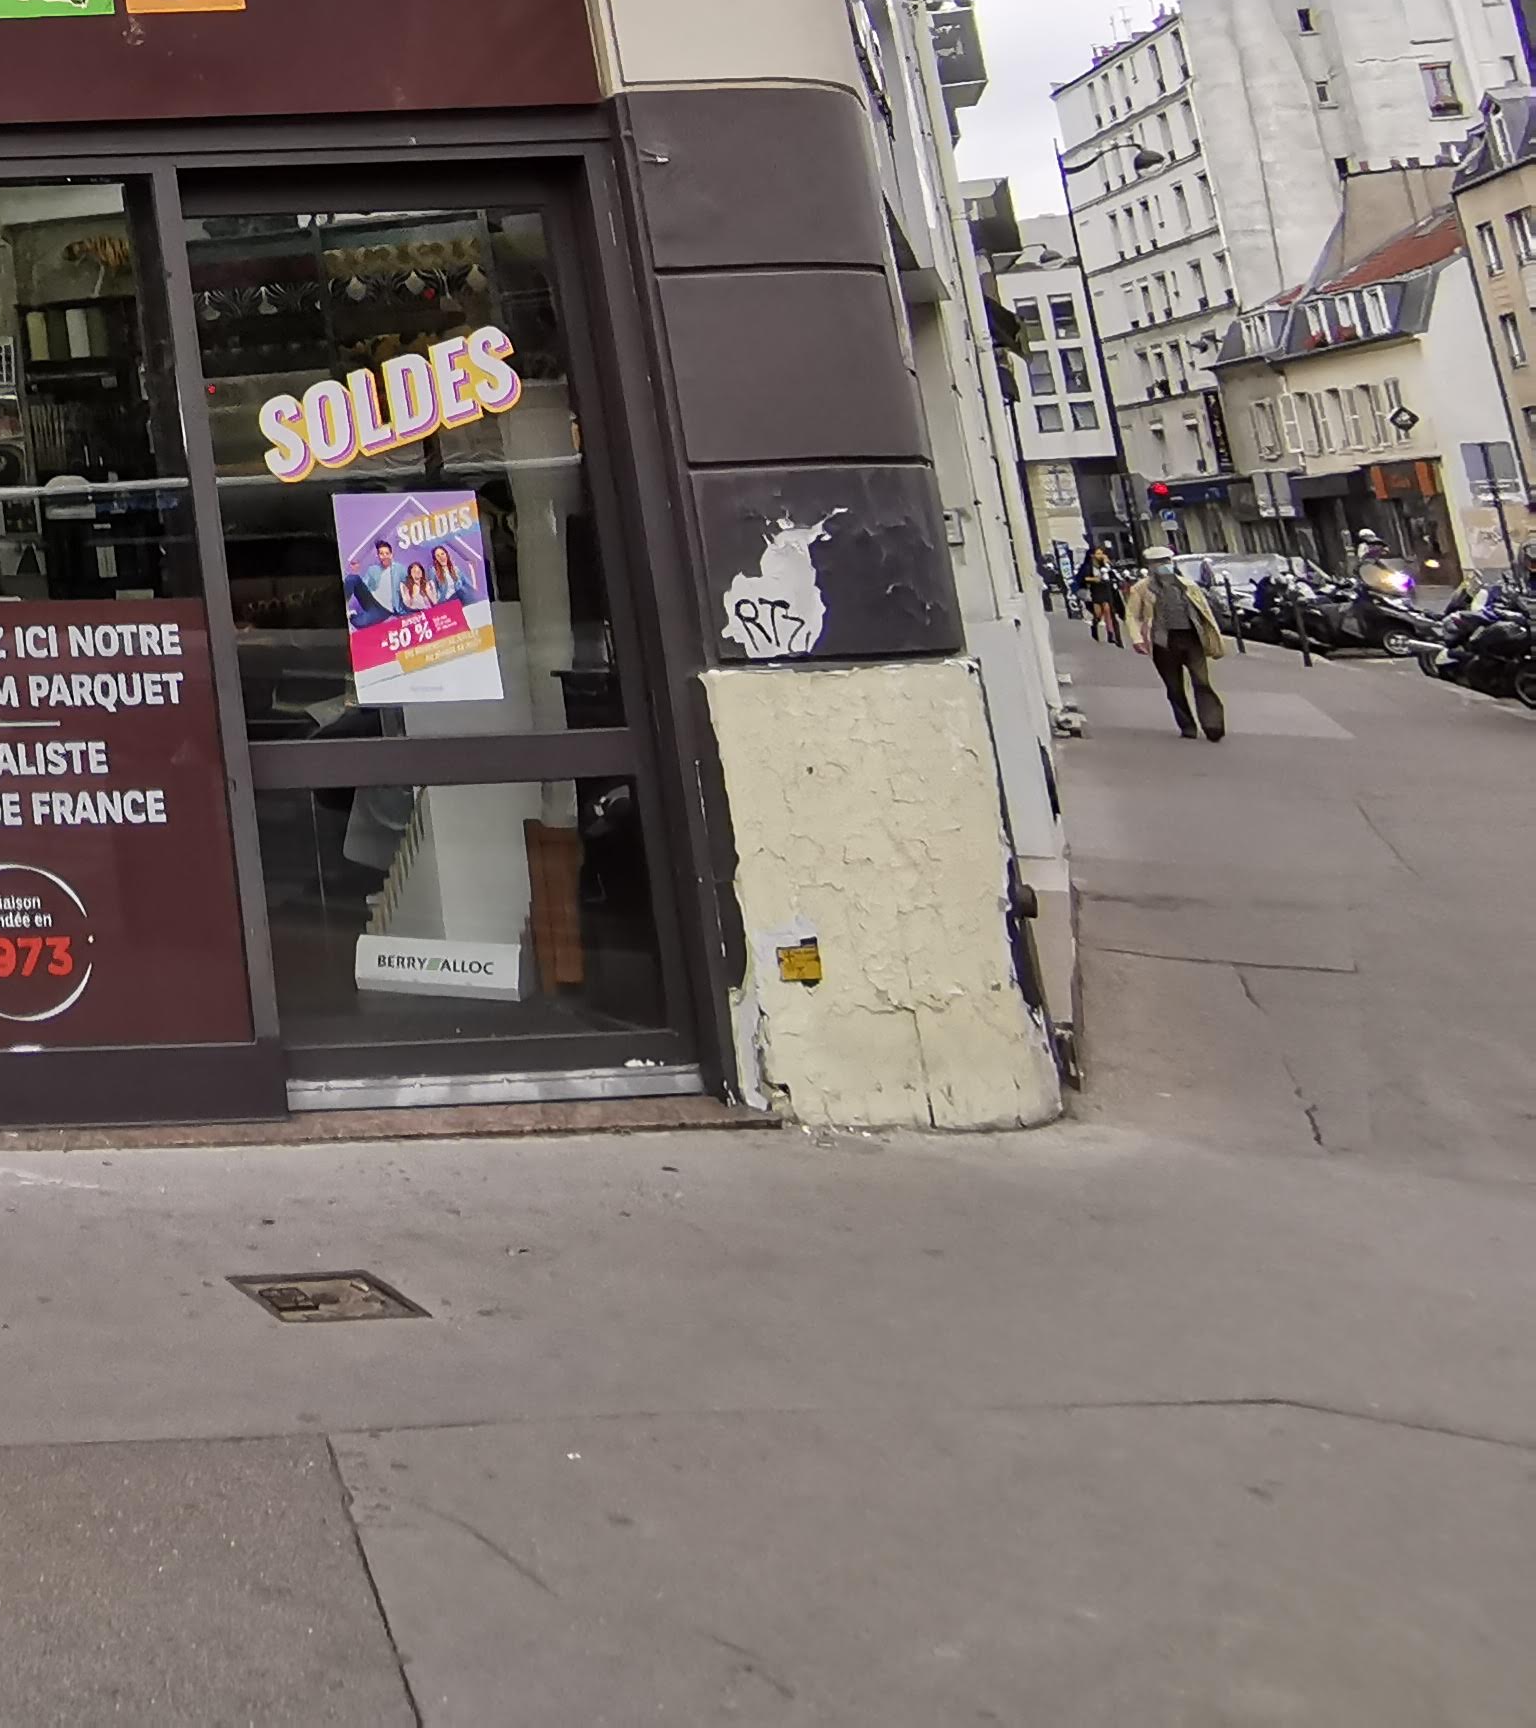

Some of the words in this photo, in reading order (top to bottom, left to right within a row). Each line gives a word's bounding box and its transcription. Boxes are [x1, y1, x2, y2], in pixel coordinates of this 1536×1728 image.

[259, 325, 521, 482] SOLDES
[397, 506, 473, 550] SOLDES
[15, 625, 59, 658] ICI
[68, 624, 182, 657] NOTRE
[29, 672, 184, 712] PARQUET
[31, 790, 167, 826] FRANCE
[34, 913, 52, 927] en
[377, 954, 427, 970] BERRY
[440, 958, 495, 975] ALLOC
